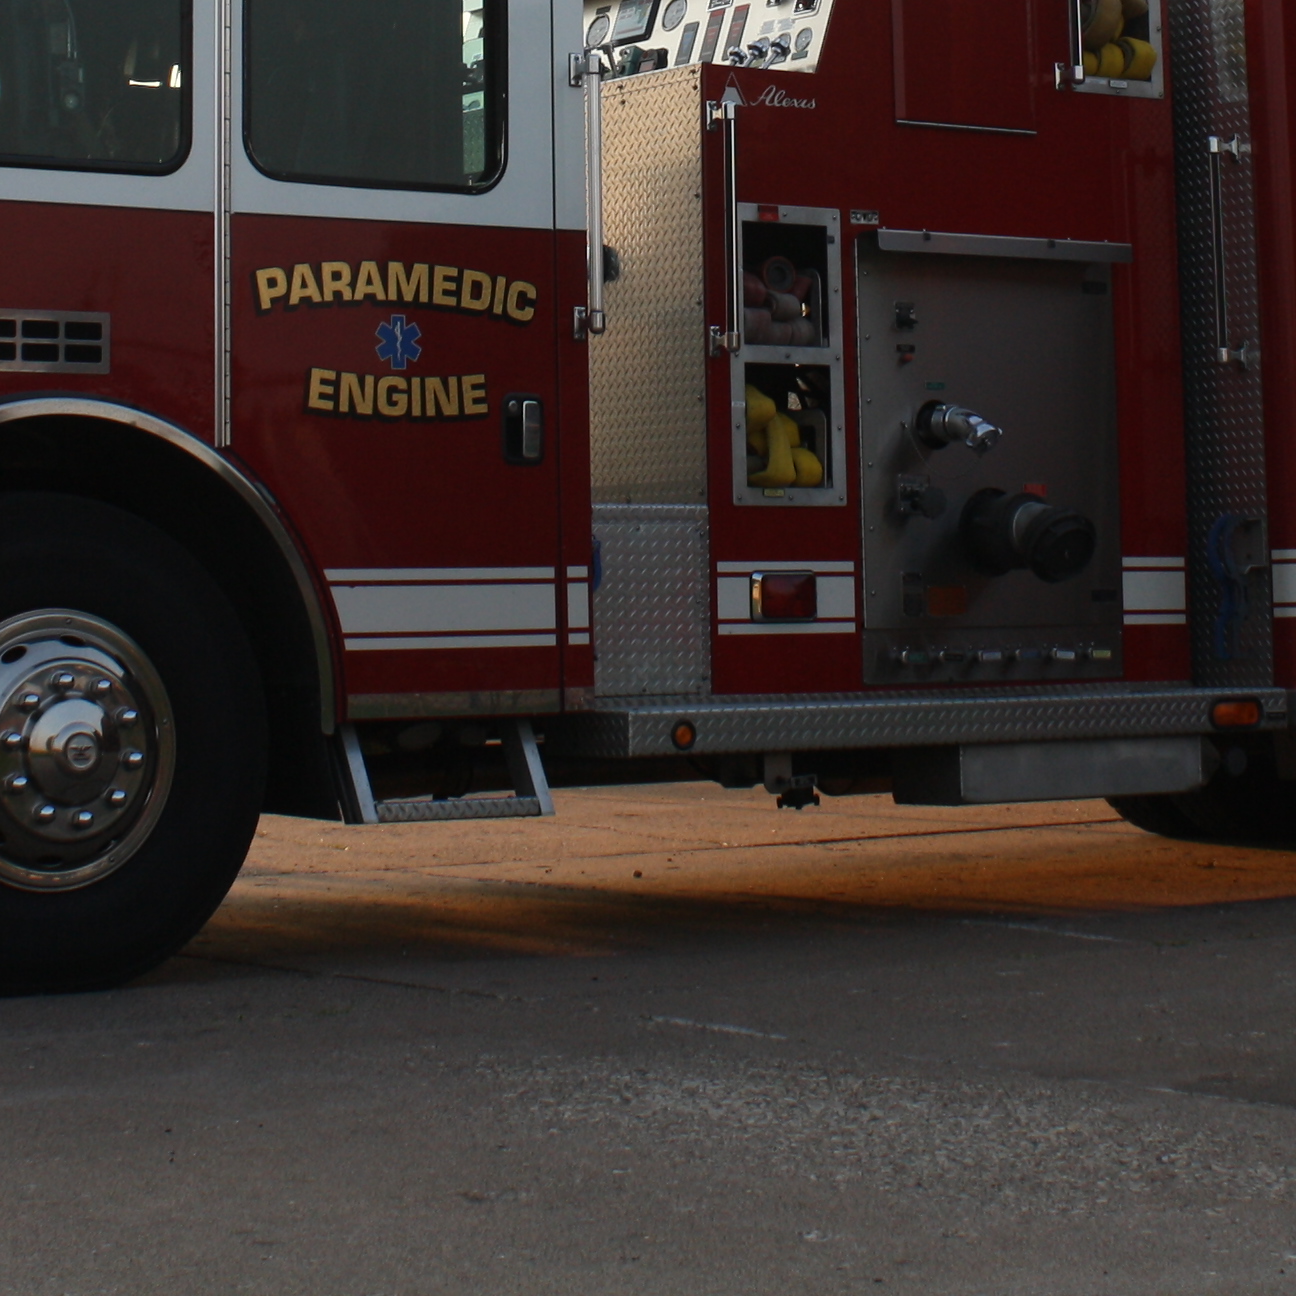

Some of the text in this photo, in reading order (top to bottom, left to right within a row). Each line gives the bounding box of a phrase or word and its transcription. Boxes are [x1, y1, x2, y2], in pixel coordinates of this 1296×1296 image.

[750, 84, 816, 110] Alexis
[254, 260, 538, 323] PARAMEDIC
[306, 367, 489, 418] ENGINE
